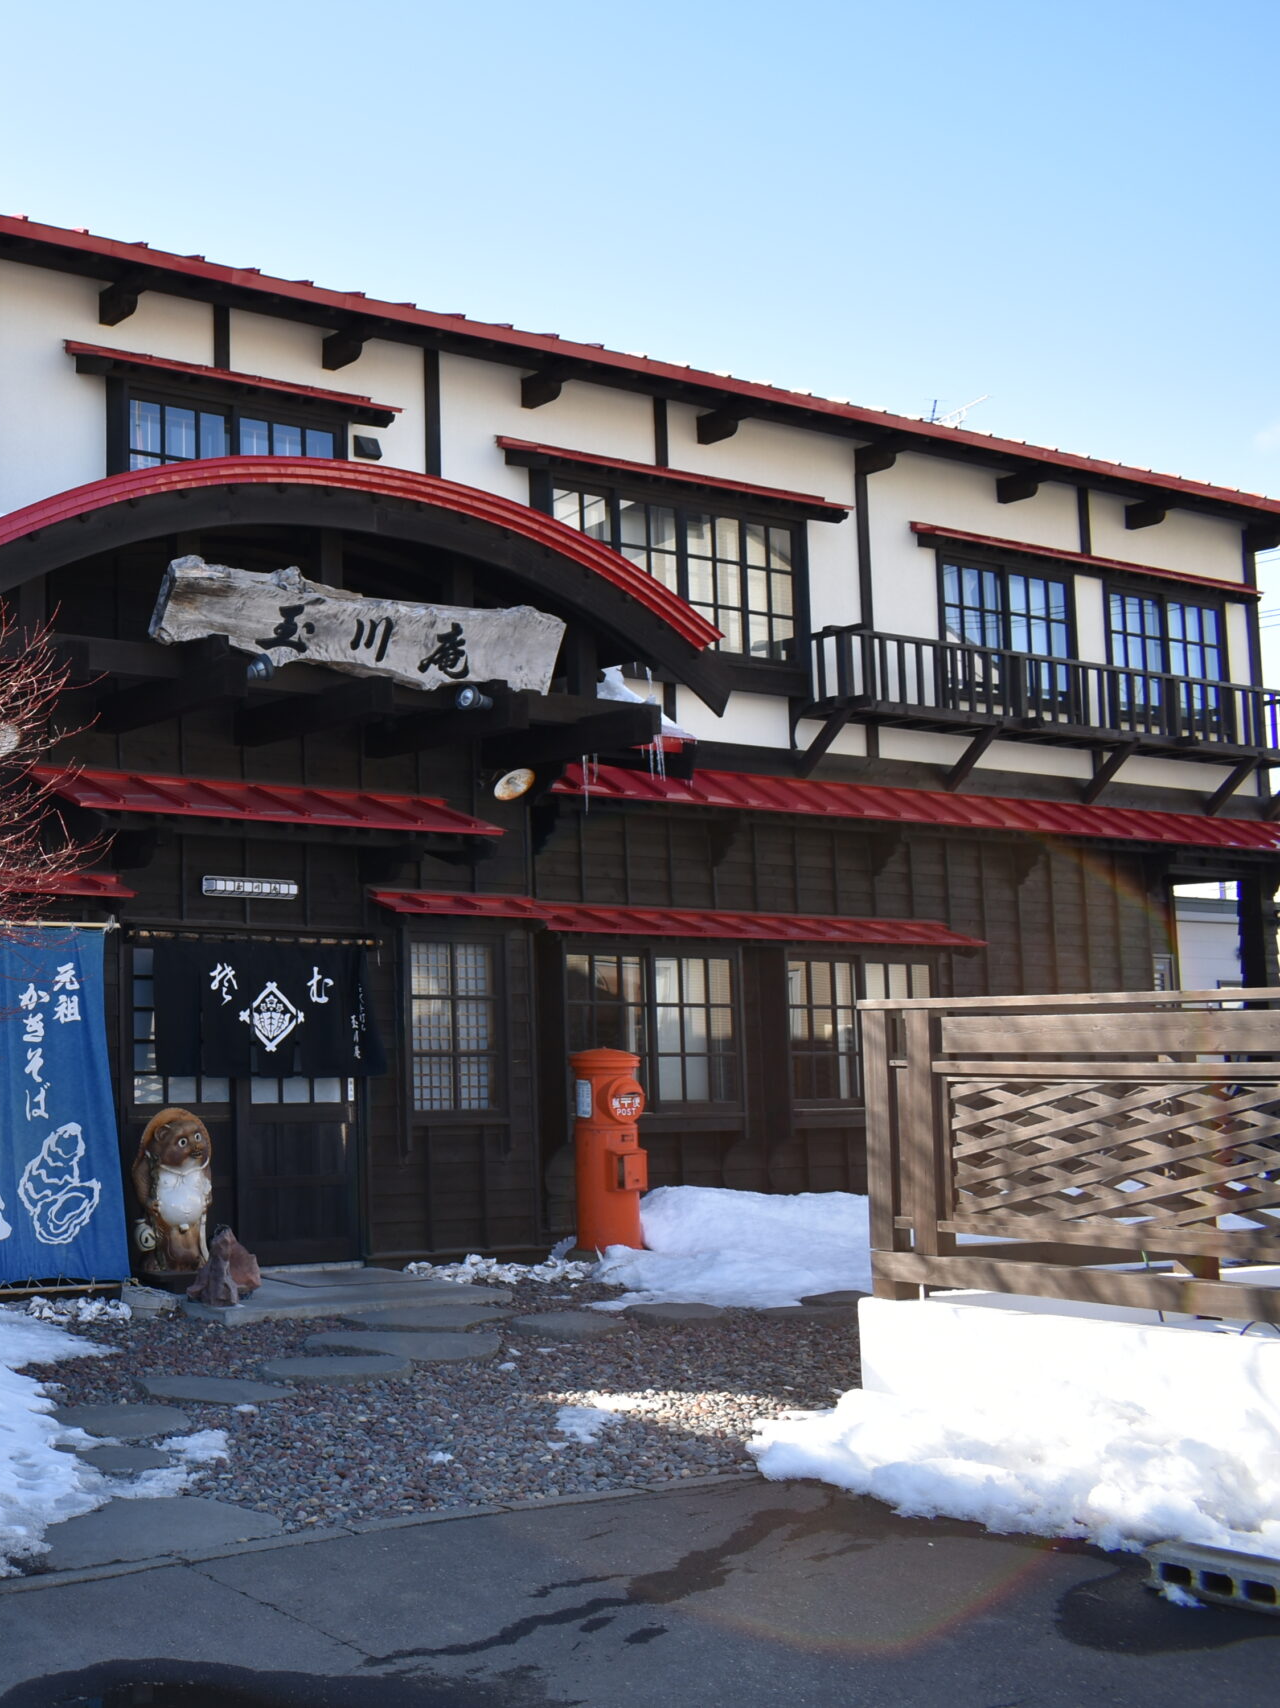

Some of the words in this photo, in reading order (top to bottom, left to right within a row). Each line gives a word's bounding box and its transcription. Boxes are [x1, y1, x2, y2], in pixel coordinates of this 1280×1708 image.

[255, 598, 470, 679] 玉川庵
[52, 961, 82, 1025] 元祖
[18, 982, 50, 1121] かきそば
[616, 1107, 637, 1117] POST
